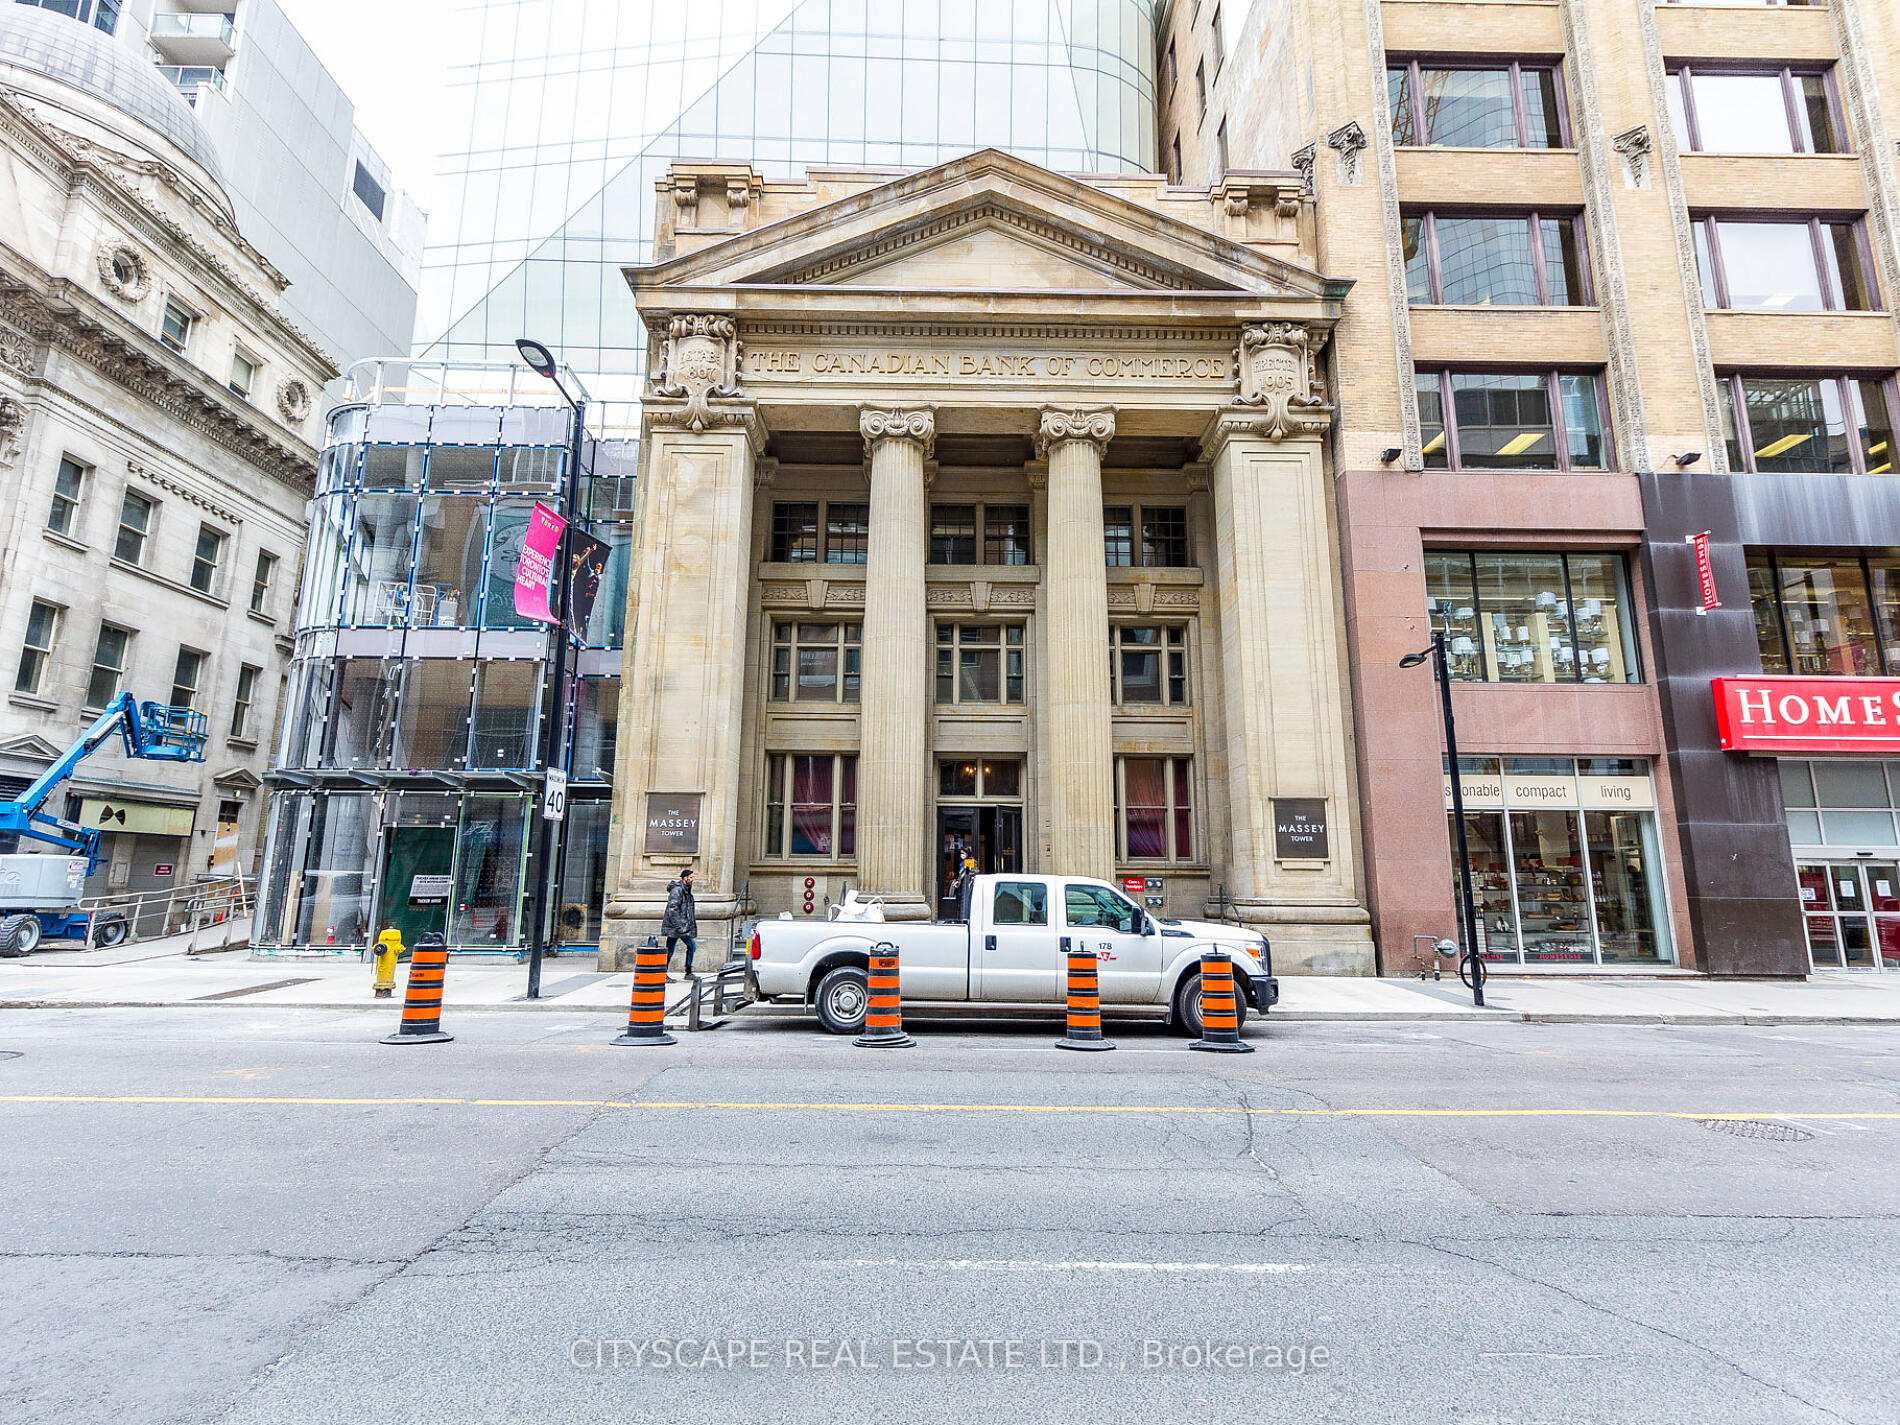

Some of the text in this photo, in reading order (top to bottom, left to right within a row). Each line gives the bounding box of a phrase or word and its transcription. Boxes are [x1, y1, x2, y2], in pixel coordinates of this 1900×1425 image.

[750, 352, 1225, 379] THE CANADIAN BANK OF COMMERCE
[1516, 785, 1567, 800] compact
[1600, 784, 1631, 801] living
[547, 790, 563, 813] 40
[649, 820, 696, 828] MASSEY
[1278, 824, 1325, 833] MASSEY
[1099, 942, 1113, 950] 178
